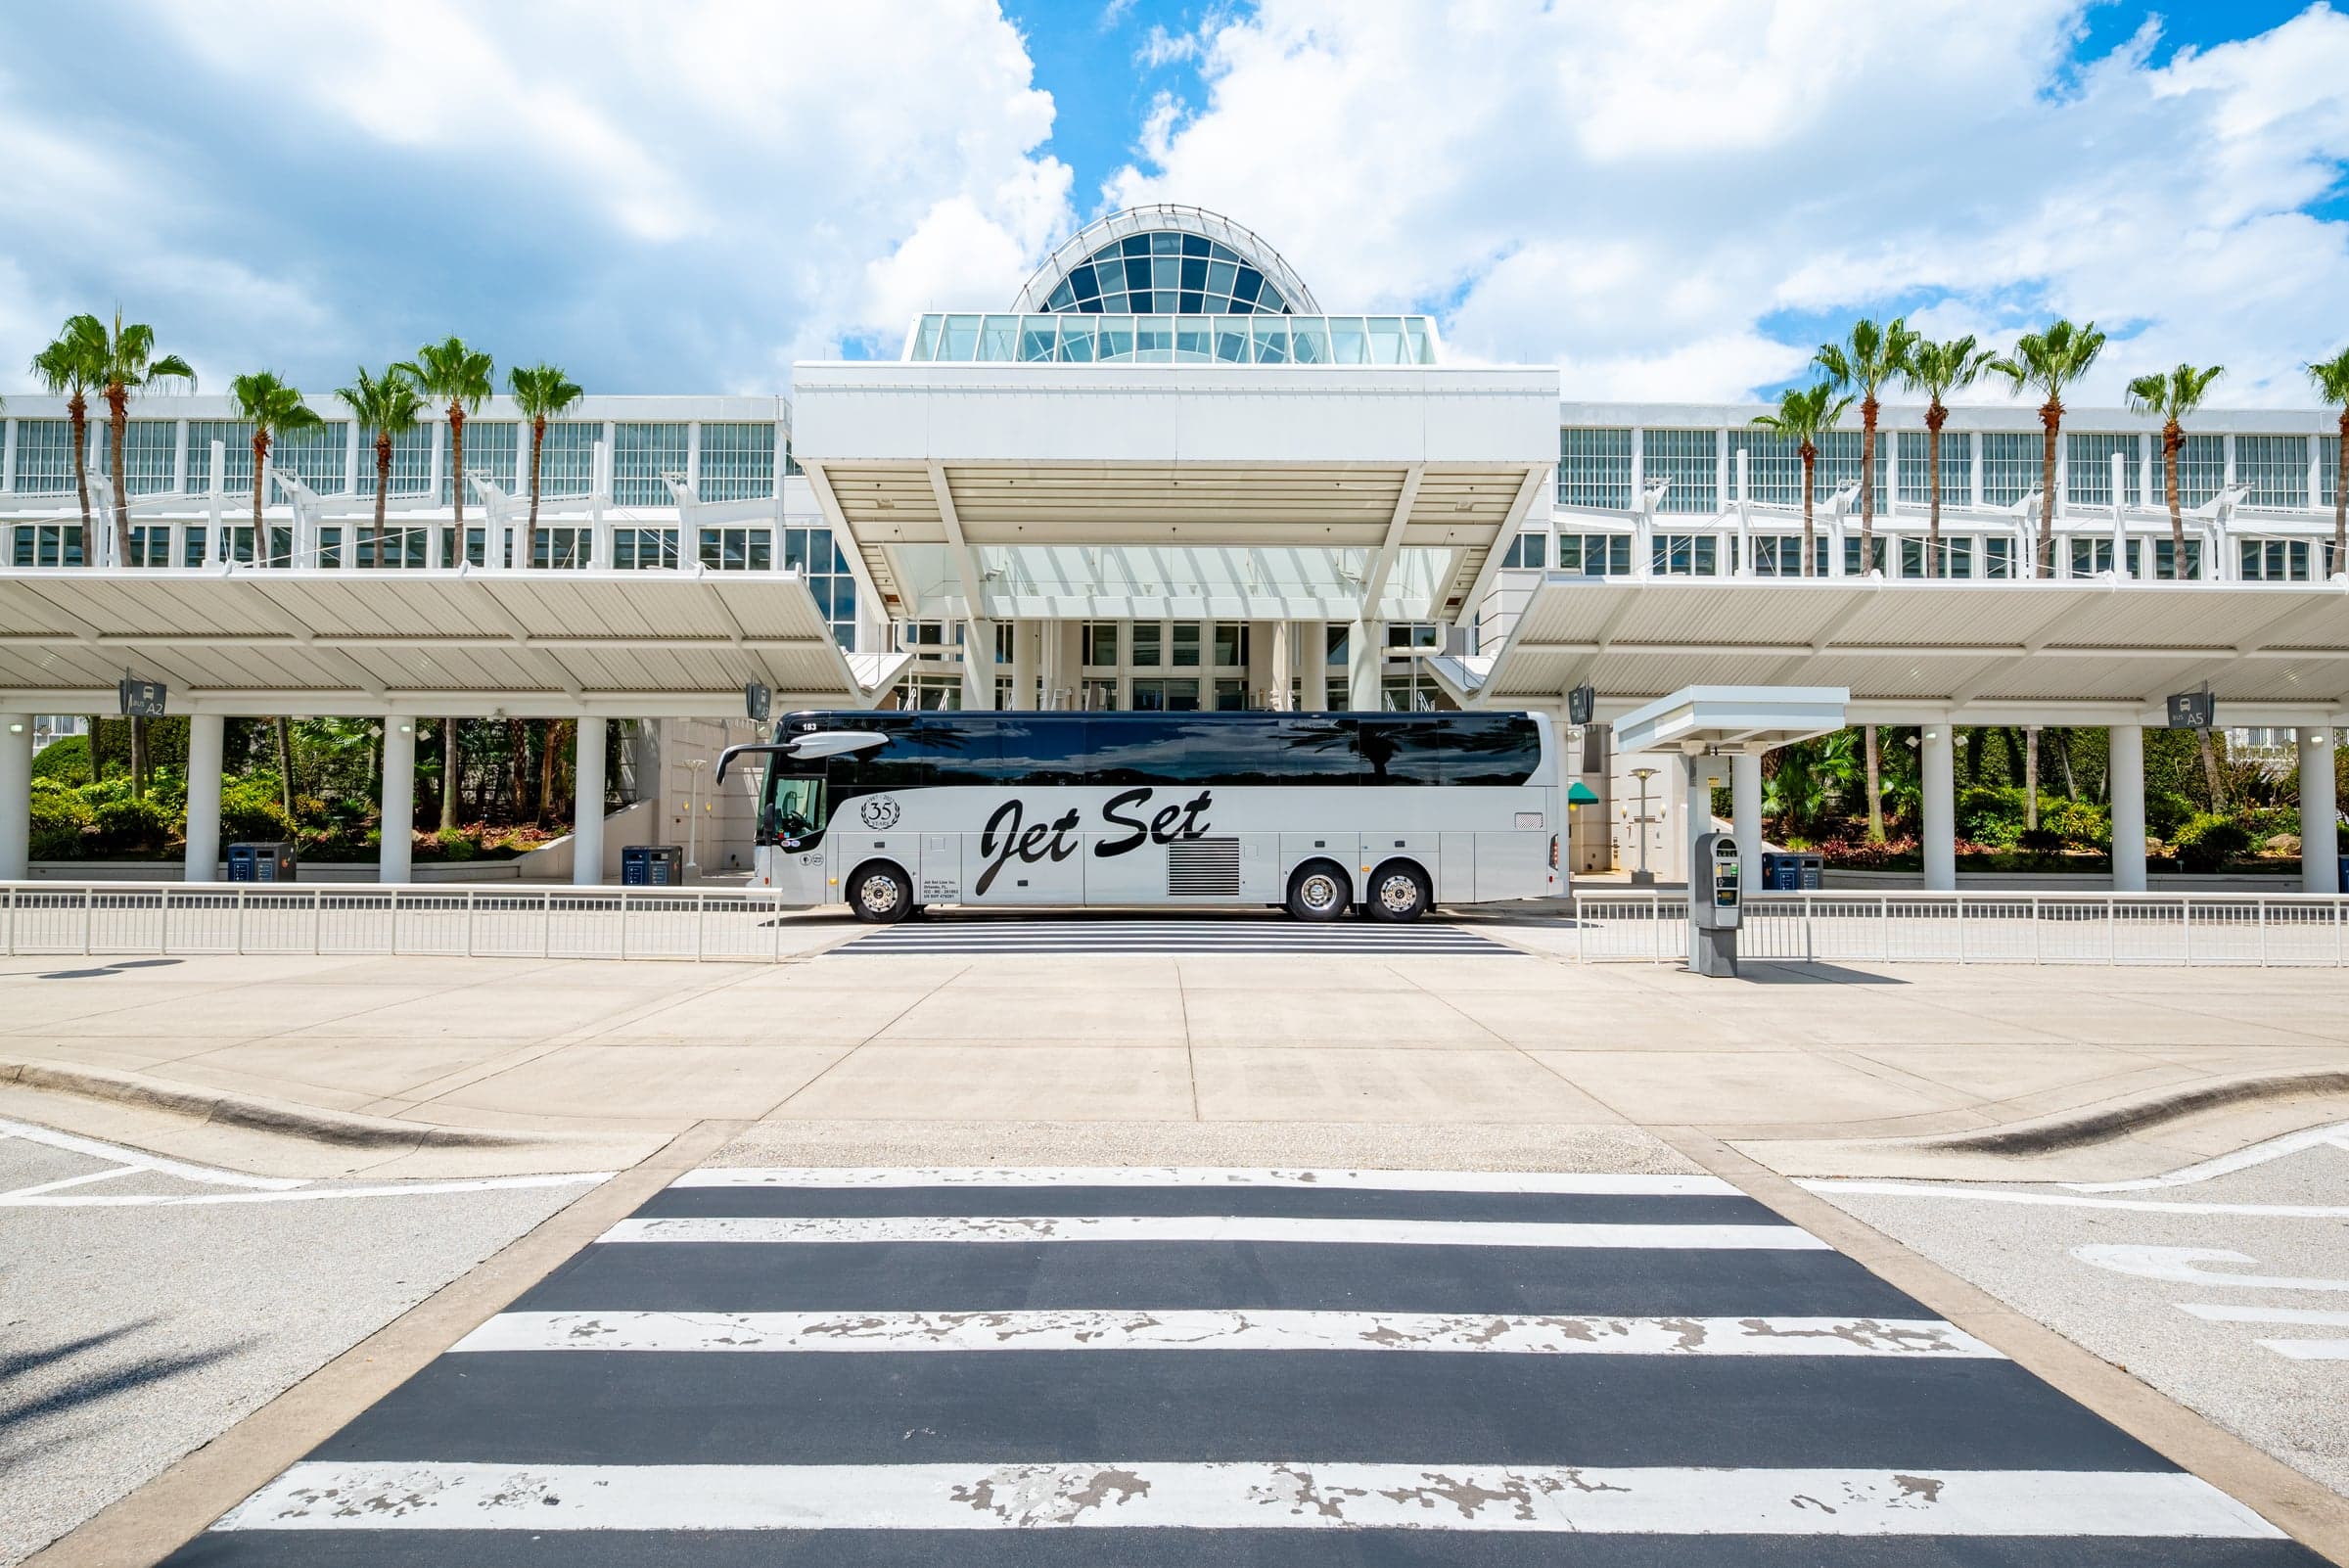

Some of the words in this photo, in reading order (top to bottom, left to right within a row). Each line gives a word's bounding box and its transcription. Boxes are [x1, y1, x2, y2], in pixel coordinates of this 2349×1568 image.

[146, 703, 163, 715] A2
[2187, 713, 2204, 725] A5
[803, 722, 816, 731] 183
[868, 803, 892, 820] 35
[975, 799, 1081, 897] Jet
[1094, 787, 1213, 857] Set
